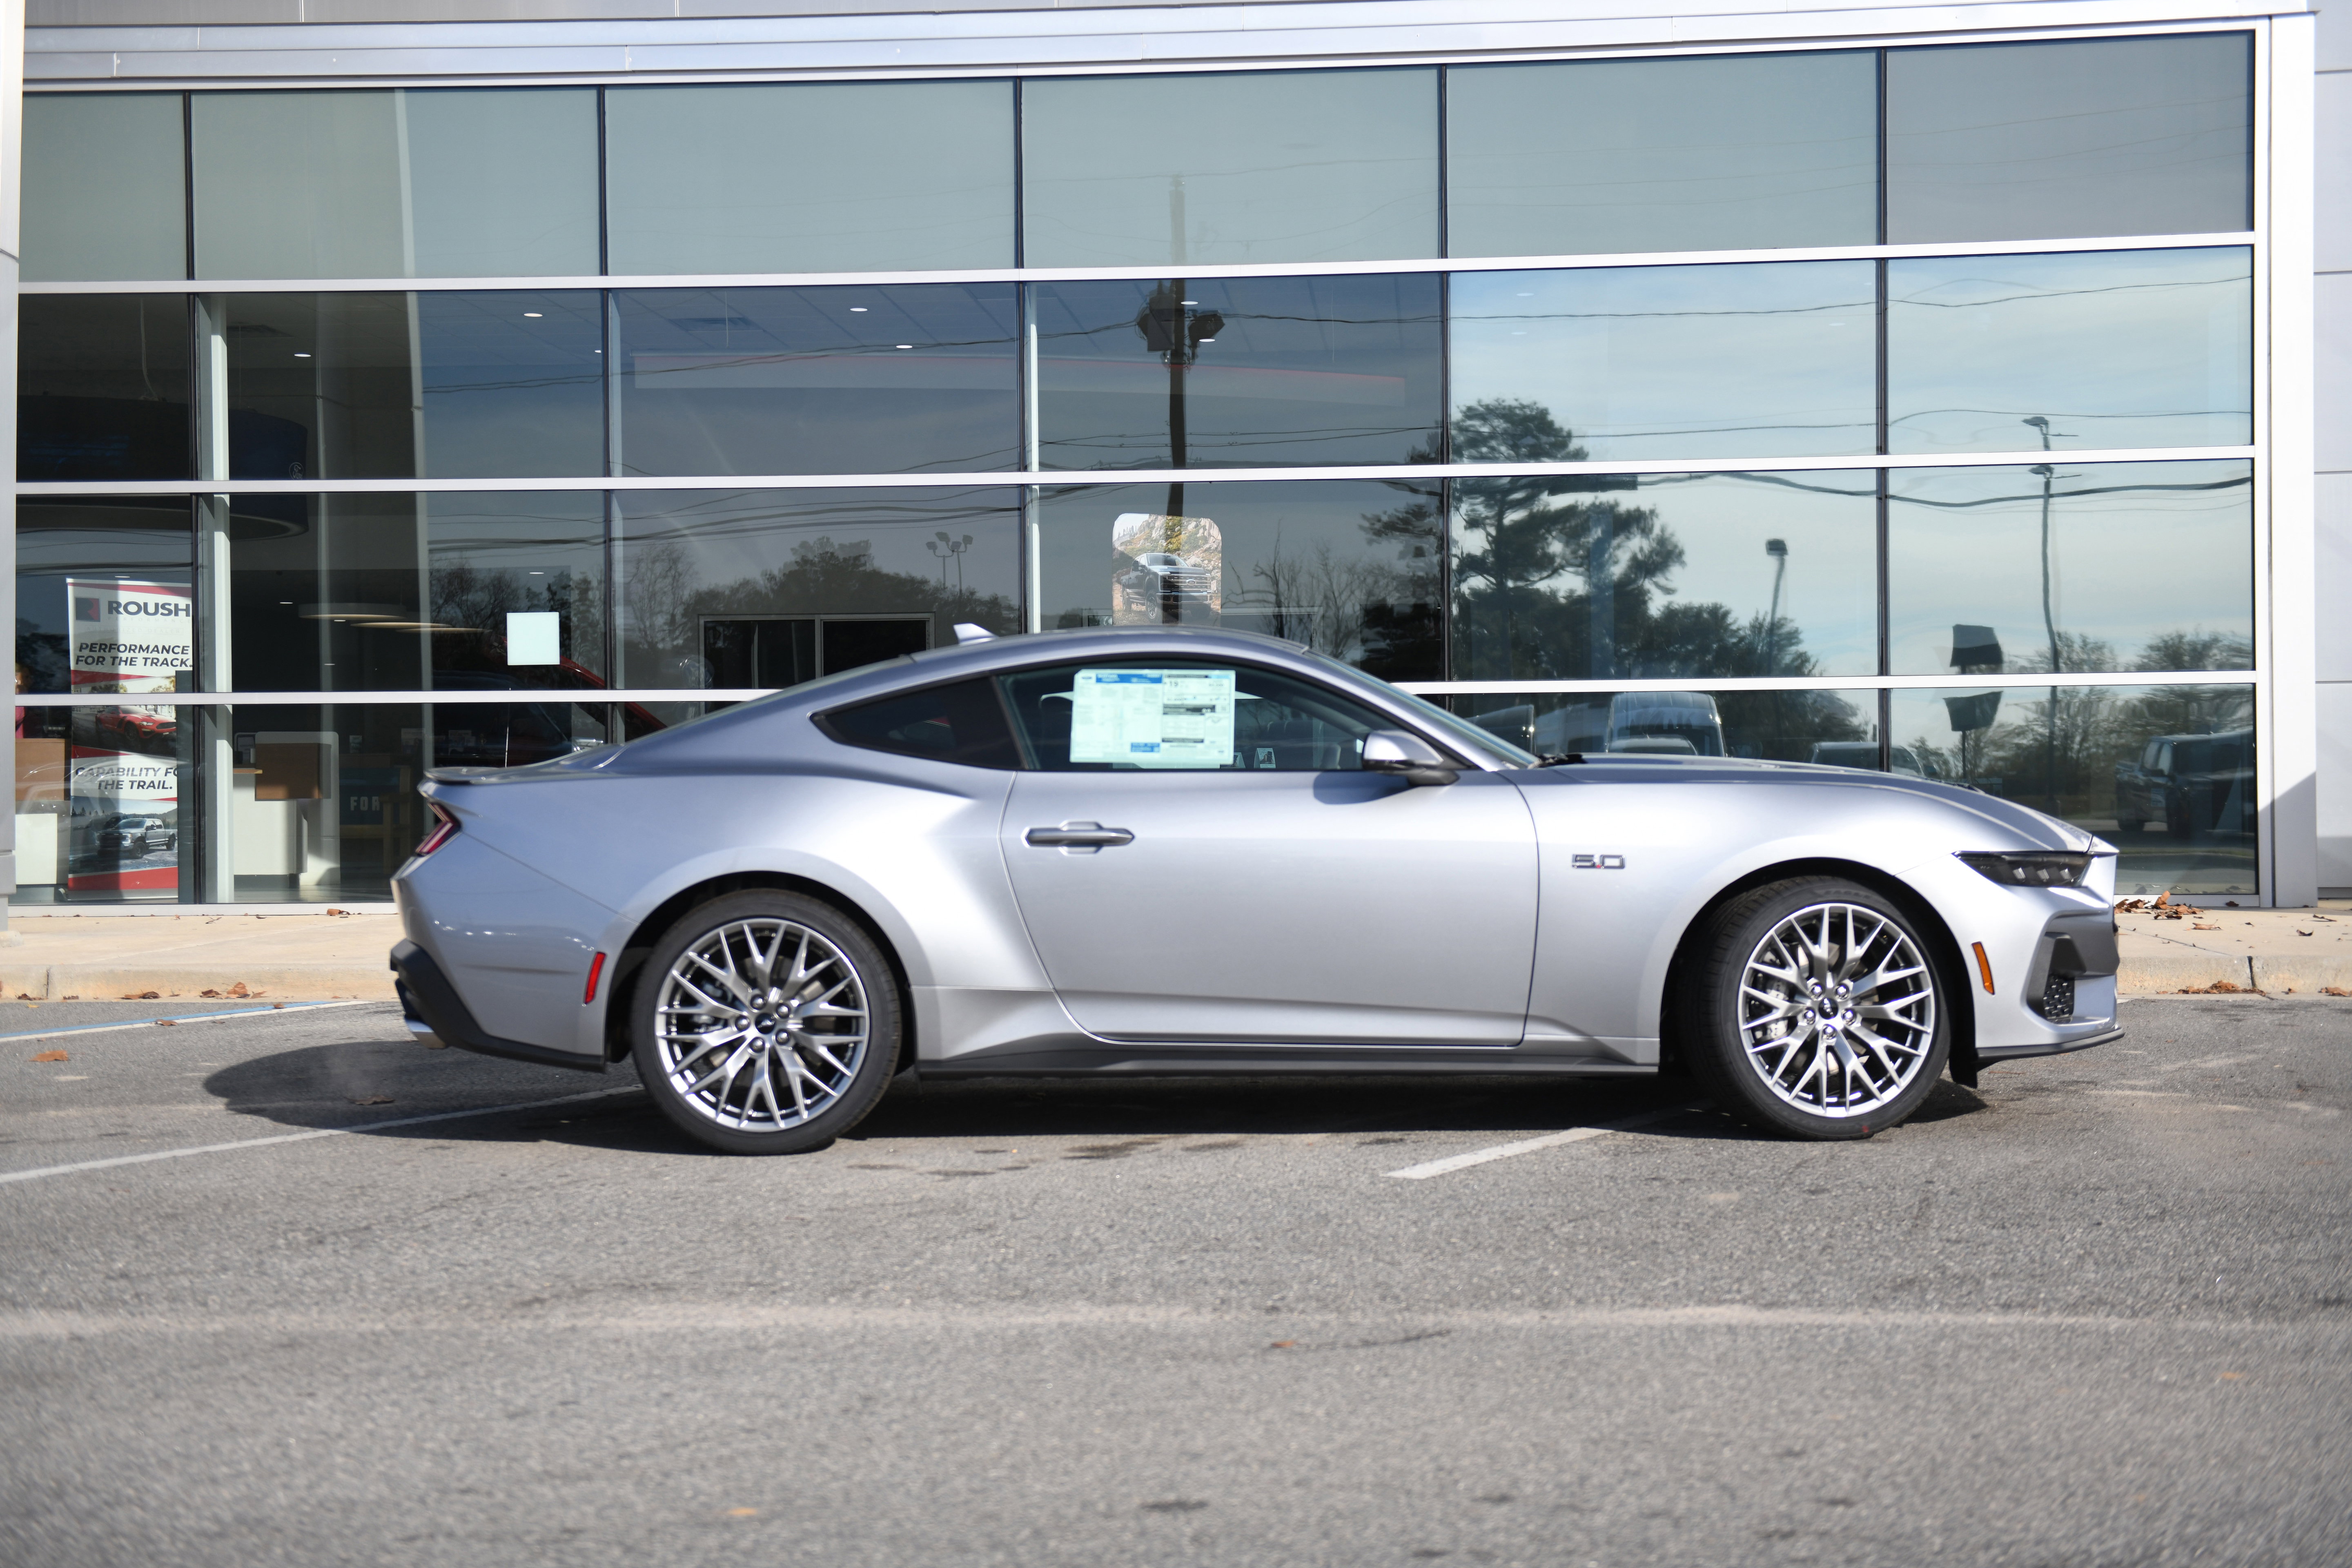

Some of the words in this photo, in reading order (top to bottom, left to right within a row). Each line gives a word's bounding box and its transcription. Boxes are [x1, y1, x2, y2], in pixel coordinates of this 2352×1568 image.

[108, 600, 190, 617] ROUSH
[79, 642, 190, 655] PERFORMANCE
[76, 655, 106, 666] FOR
[107, 656, 138, 666] THE
[143, 657, 193, 668] TRACK.
[76, 767, 161, 777] CAPABILITY
[98, 780, 124, 790] THE
[129, 780, 173, 790] TRAIL.
[1572, 853, 1626, 870] 5.0
